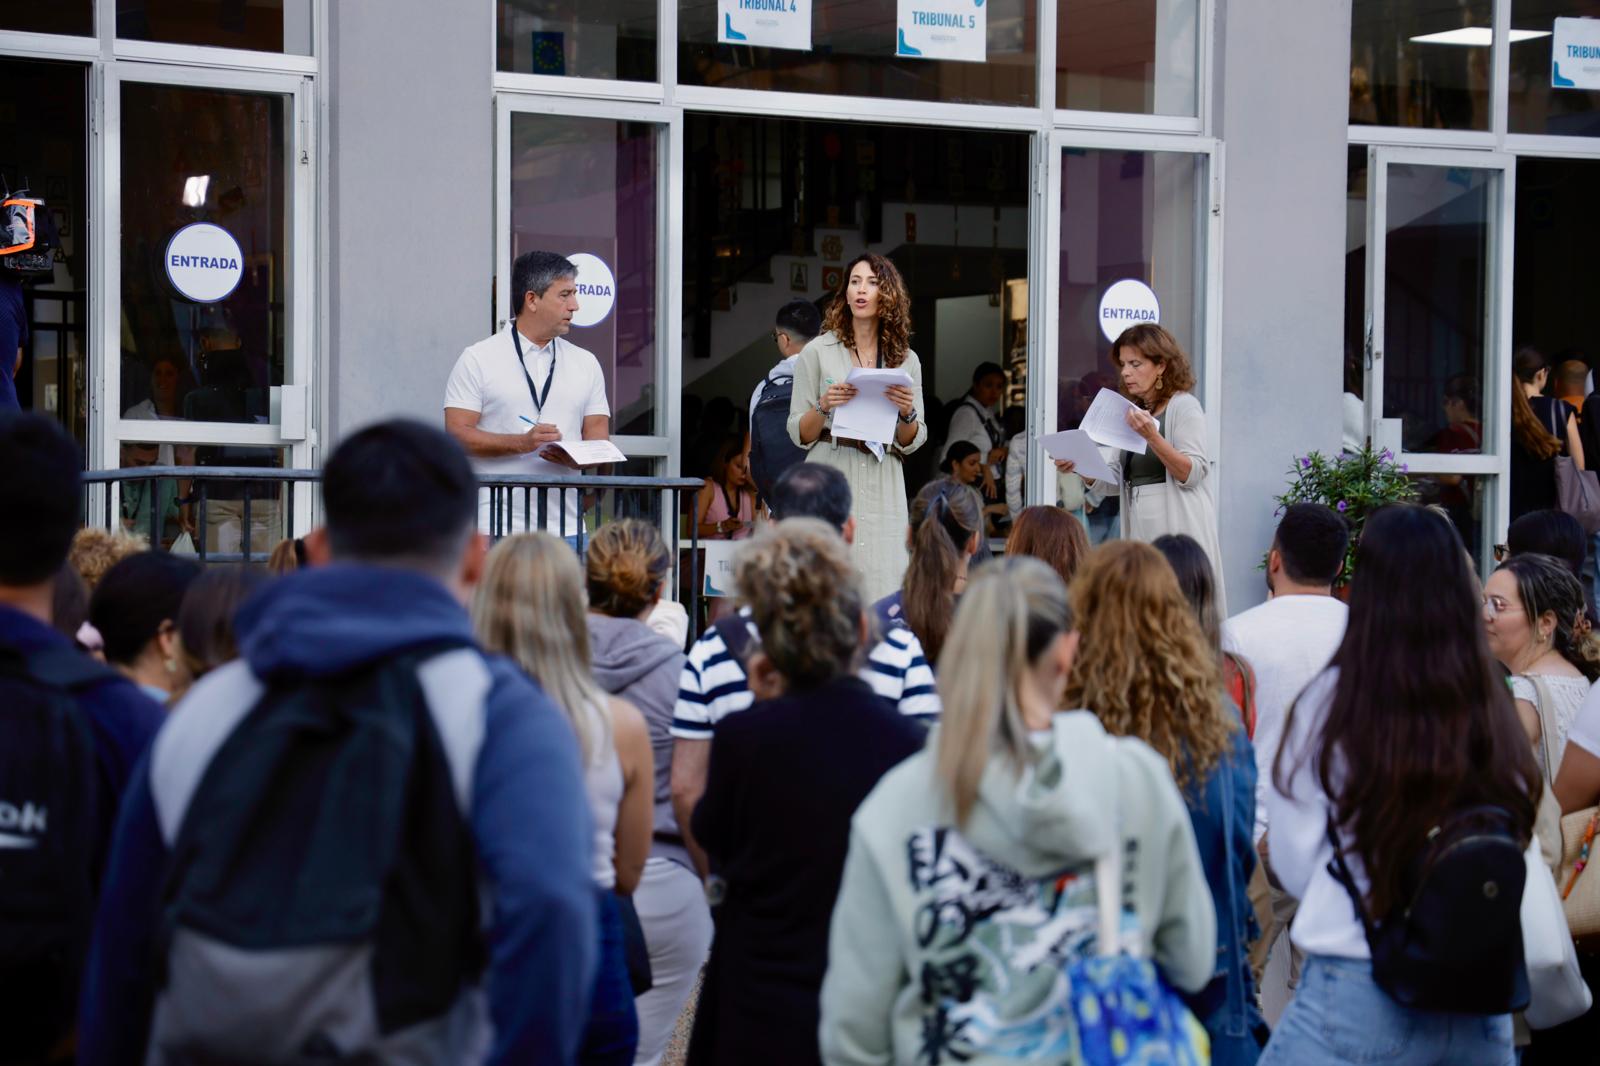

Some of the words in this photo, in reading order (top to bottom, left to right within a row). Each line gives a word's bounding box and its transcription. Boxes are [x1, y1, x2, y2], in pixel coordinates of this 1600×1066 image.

[790, 0, 796, 12] 4
[912, 11, 965, 28] TRIBUNAL
[969, 15, 975, 28] 5
[171, 254, 238, 270] ENTRADA
[576, 284, 612, 297] RADA
[1103, 307, 1156, 320] ENTRADA
